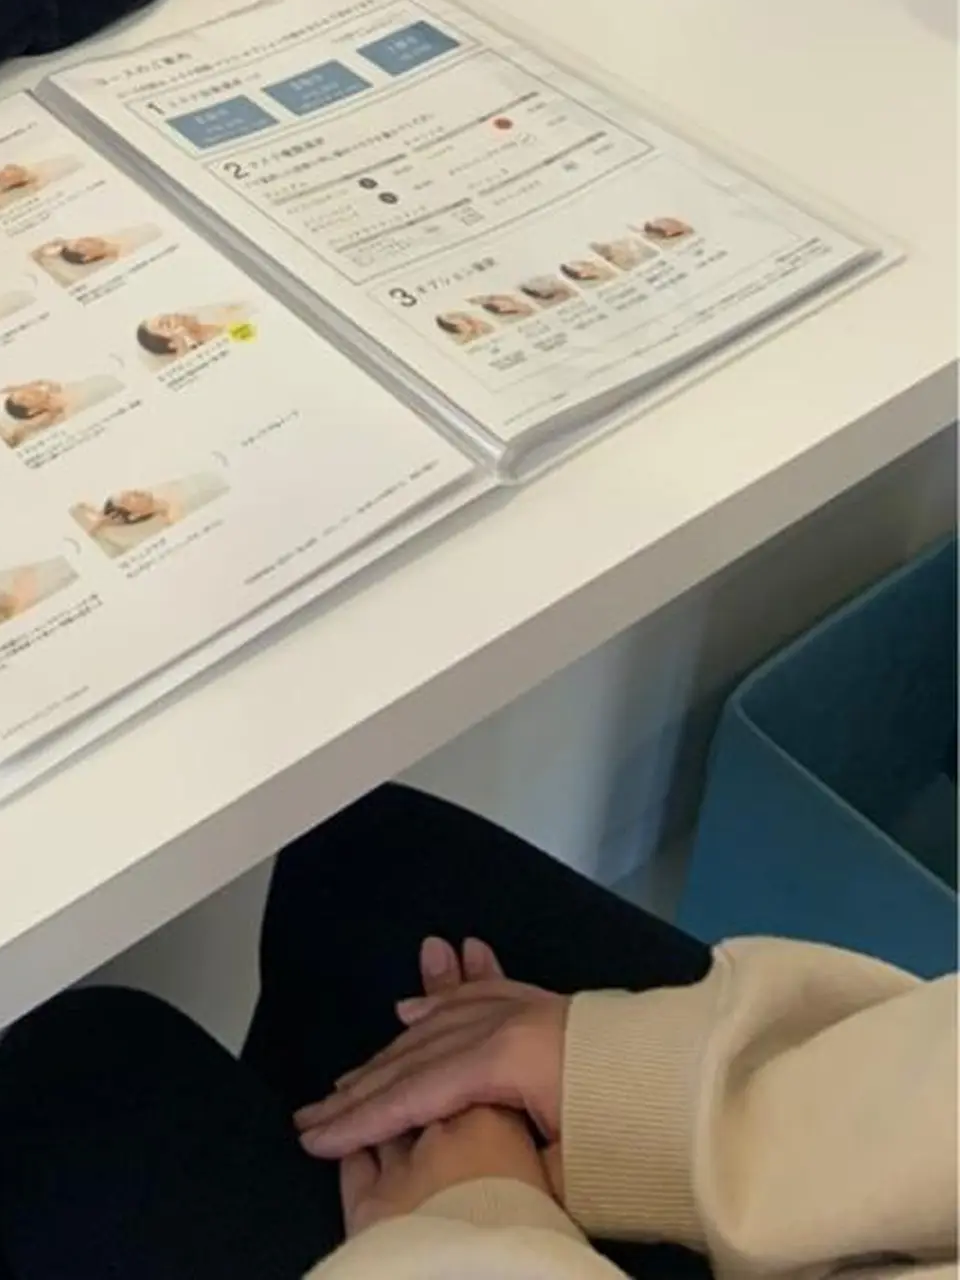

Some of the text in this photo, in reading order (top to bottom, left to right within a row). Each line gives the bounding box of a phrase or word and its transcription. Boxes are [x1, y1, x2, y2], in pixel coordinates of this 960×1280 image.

[146, 101, 166, 117] 1
[223, 161, 250, 181] 2
[388, 287, 418, 308] 3
